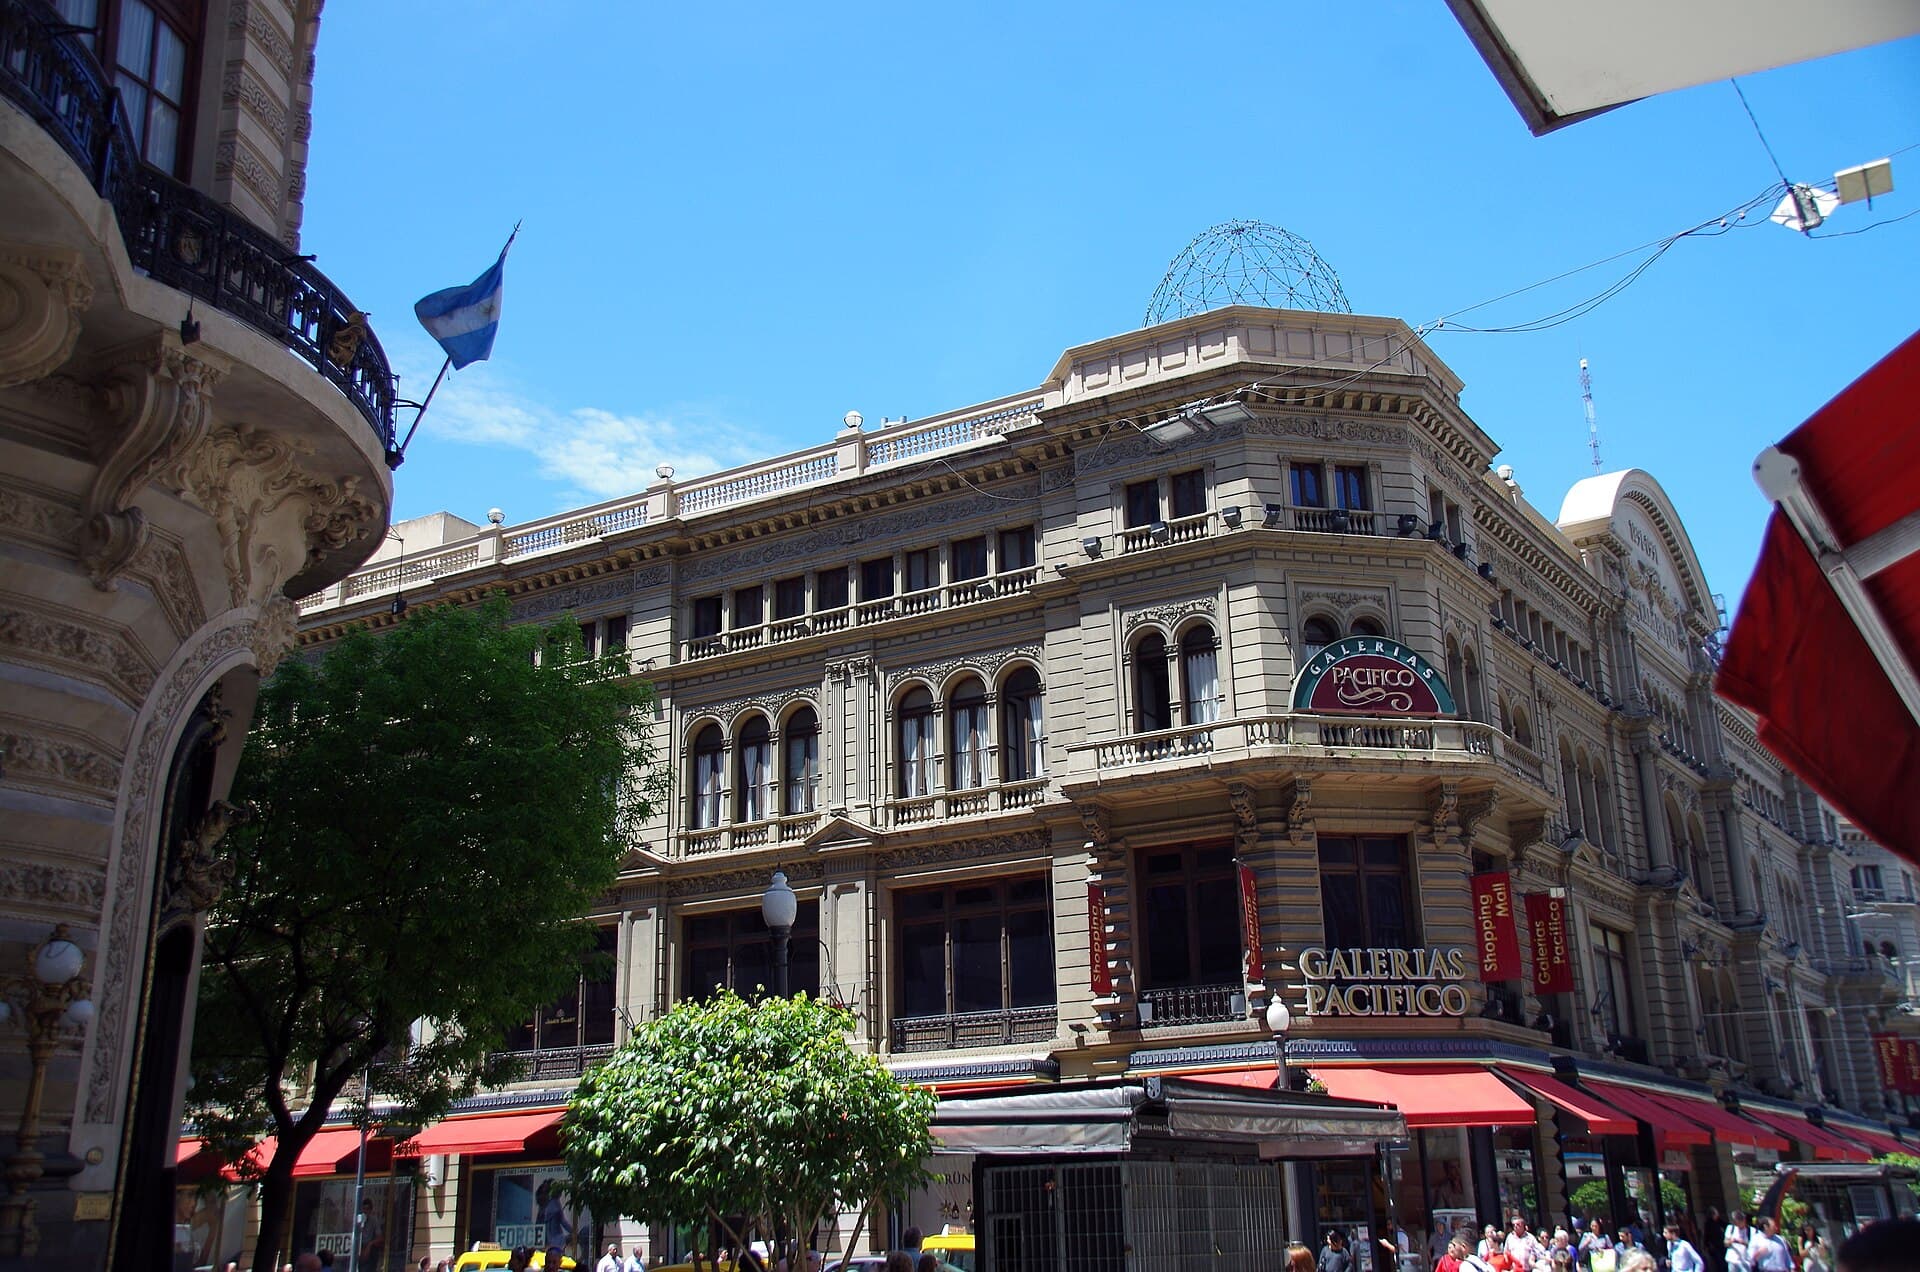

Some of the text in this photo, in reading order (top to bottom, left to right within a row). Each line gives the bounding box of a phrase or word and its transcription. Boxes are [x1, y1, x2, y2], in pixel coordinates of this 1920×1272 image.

[1310, 640, 1434, 679] GALERIAS
[1332, 666, 1415, 692] PACIFICO
[1492, 882, 1509, 917] Mall
[1092, 905, 1101, 983] Shopping
[1478, 894, 1498, 972] Shopping
[1299, 947, 1467, 980] GALERIAS
[1303, 984, 1471, 1016] PACIFICO
[497, 1226, 544, 1248] FORCE
